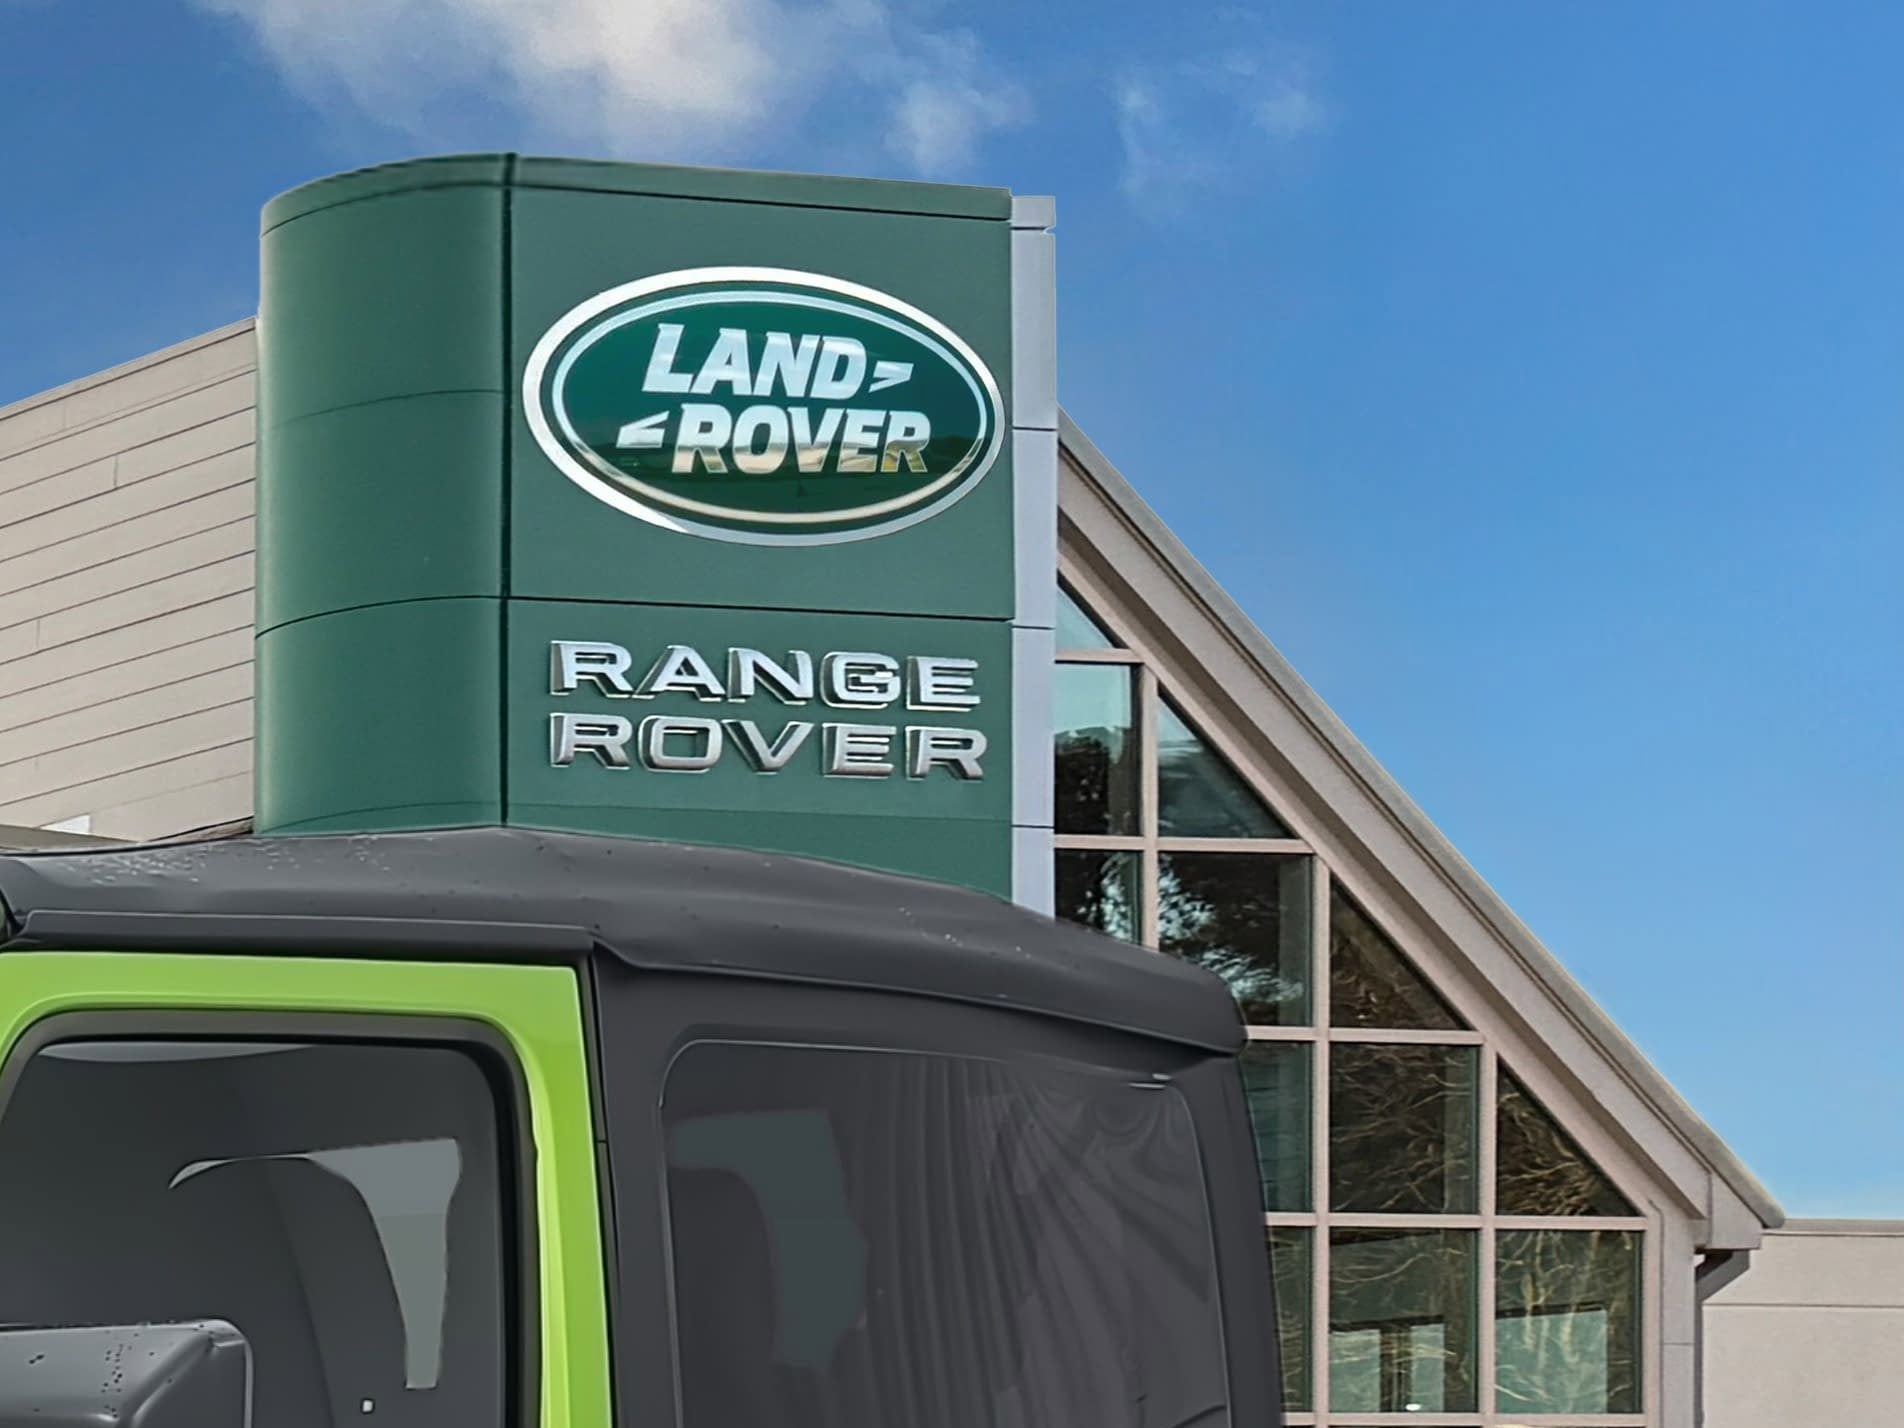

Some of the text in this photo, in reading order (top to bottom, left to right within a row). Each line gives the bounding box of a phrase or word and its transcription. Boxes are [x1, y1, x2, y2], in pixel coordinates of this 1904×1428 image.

[641, 322, 868, 399] LAND
[671, 402, 932, 474] ROVER
[549, 639, 982, 712] RANGE
[549, 711, 989, 781] ROVER
